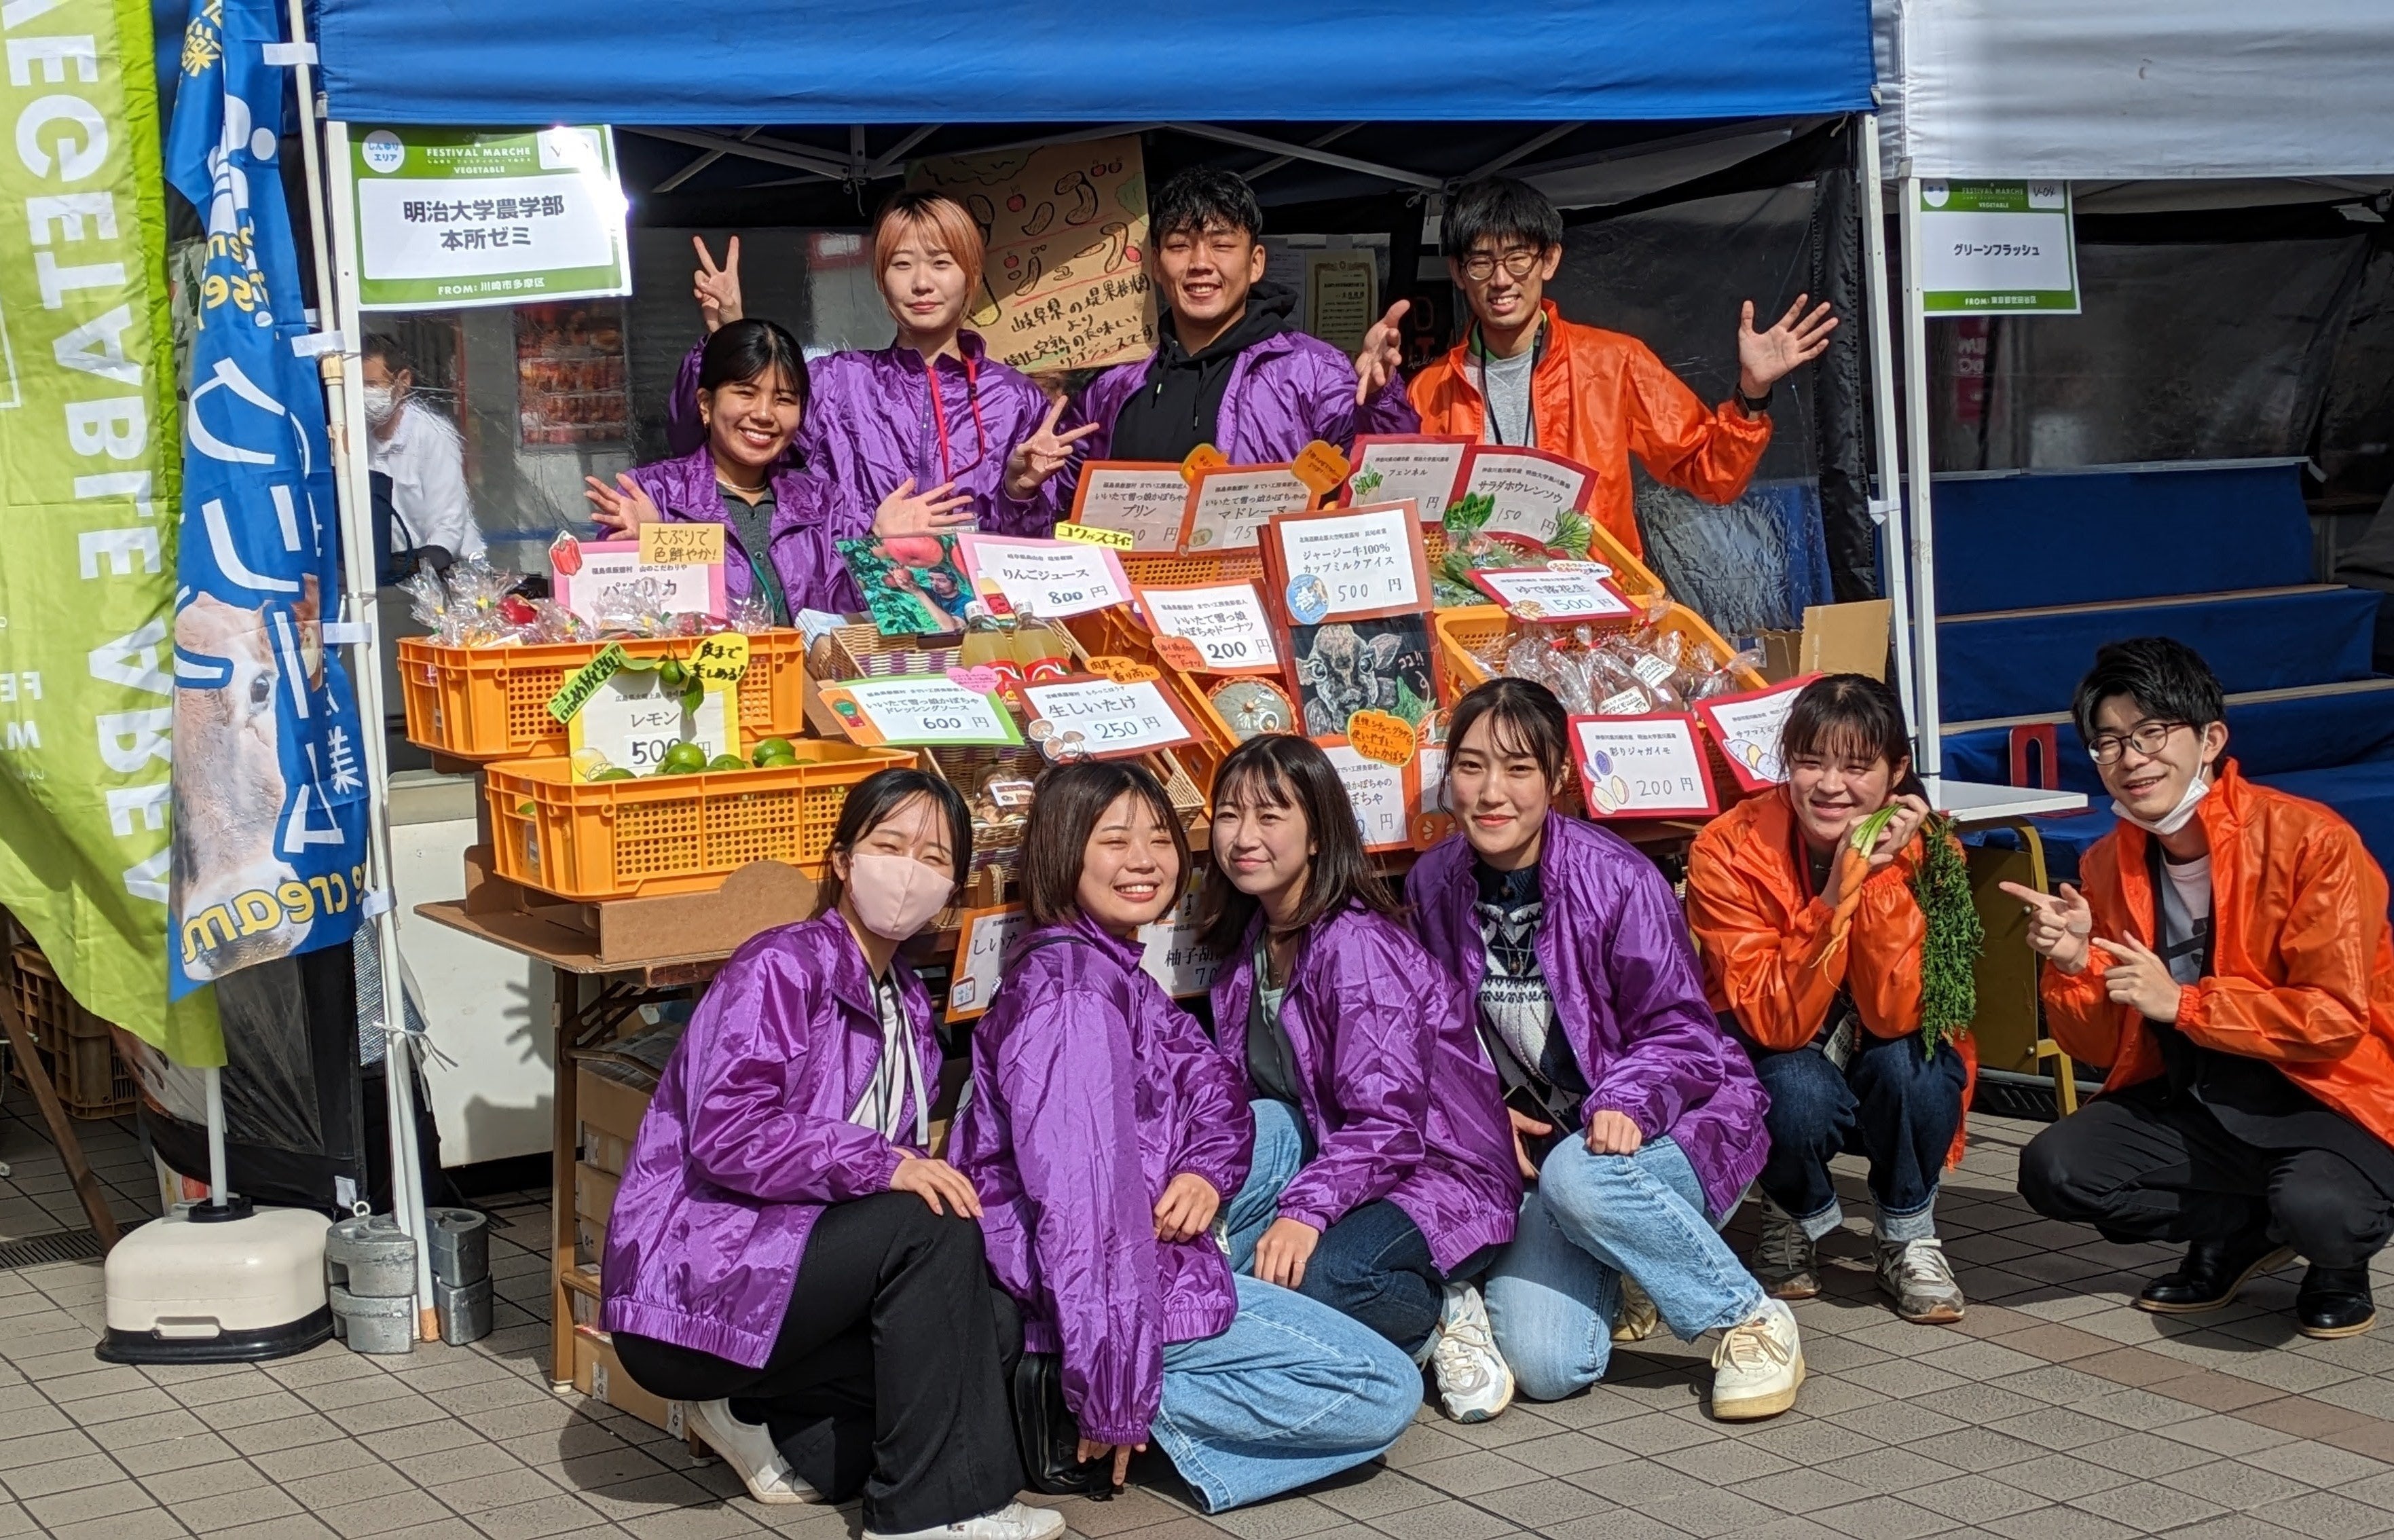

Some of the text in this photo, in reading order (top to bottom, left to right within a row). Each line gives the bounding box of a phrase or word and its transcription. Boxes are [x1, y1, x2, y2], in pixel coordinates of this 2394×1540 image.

[373, 153, 398, 162] エリア
[426, 147, 531, 157] FESTIVAL MARCHE
[454, 166, 506, 175] VEGETABLE
[403, 195, 565, 223] 明治大学農学部
[440, 227, 532, 251] 本所ゼミ
[1954, 244, 2040, 256] グリーンフラッシュ
[438, 285, 477, 296] FROM:
[1068, 314, 1093, 331] より
[1388, 468, 1429, 477] フェンネル
[1478, 480, 1563, 503] サラダホウレンソウ
[1122, 504, 1156, 517] プリン
[1426, 496, 1440, 509] 円
[1219, 505, 1287, 519] マドレーヌ
[1496, 508, 1555, 535] 150 円
[652, 527, 710, 545] 大ぶりで
[1164, 528, 1179, 541] 円
[655, 547, 716, 563] 色鮮やか!
[1303, 543, 1391, 560] ジャージー牛100%
[1304, 556, 1395, 574] カップミルクアイス
[1003, 568, 1089, 581] りんごジュース
[1048, 585, 1108, 604] 800 円
[1338, 578, 1402, 602] 500 円
[1553, 598, 1615, 610] 500 円
[1177, 622, 1253, 637] かぼちゃドーナツ
[699, 642, 743, 660] 皮まで
[1207, 638, 1272, 659] 200 円
[689, 663, 745, 680] 楽しめる!
[1090, 659, 1125, 670] 肉厚で
[887, 705, 970, 714] ドレッシングソース
[1049, 695, 1136, 718] 生しいたけ
[631, 712, 680, 728] レモン
[923, 716, 989, 729] 600 円
[1094, 716, 1160, 739] 250 円
[1609, 746, 1671, 756] 彩りジャガイモ
[1636, 777, 1693, 796] 200 円
[1380, 813, 1393, 830] 円
